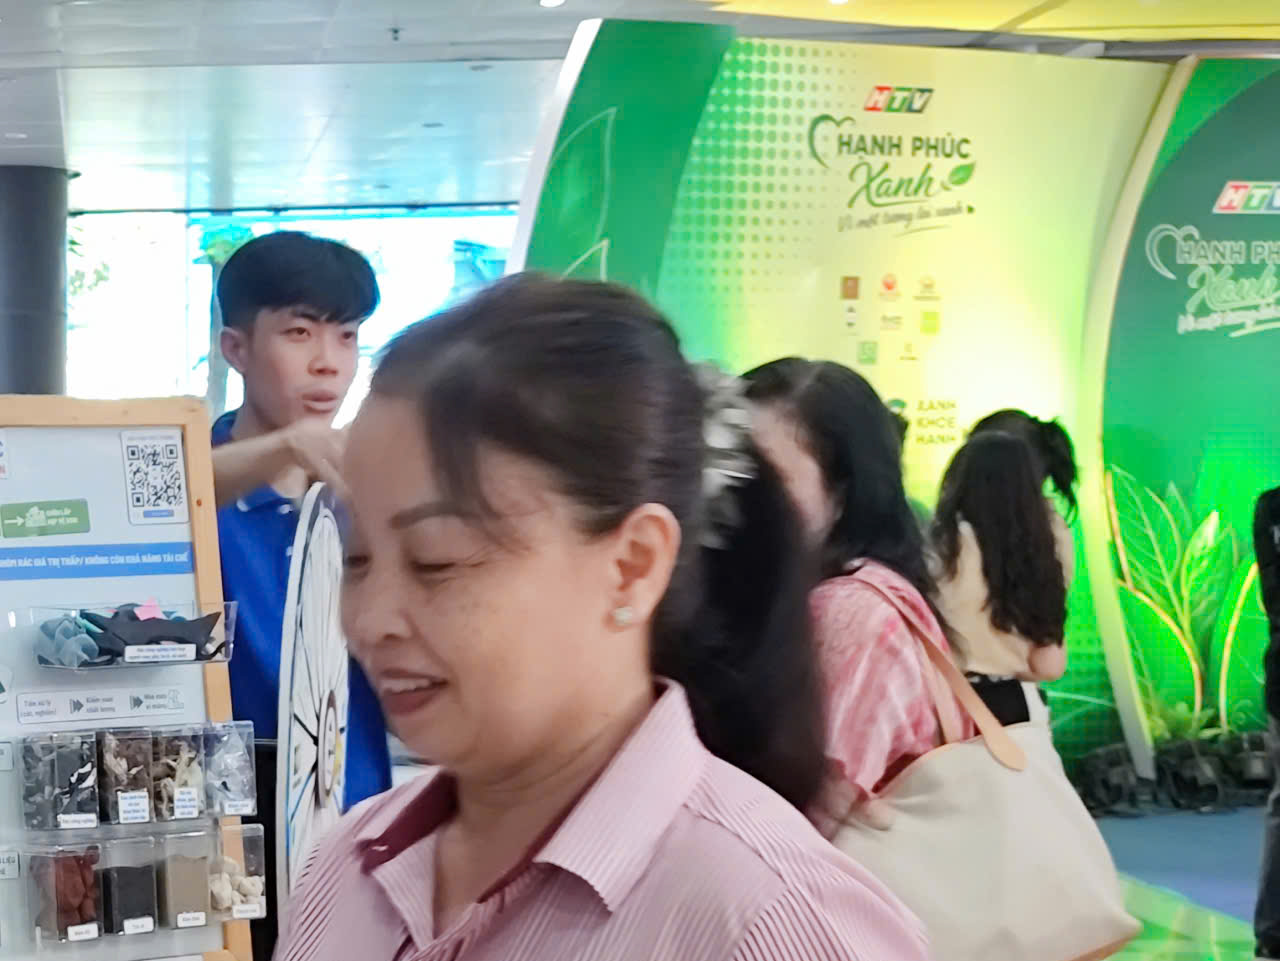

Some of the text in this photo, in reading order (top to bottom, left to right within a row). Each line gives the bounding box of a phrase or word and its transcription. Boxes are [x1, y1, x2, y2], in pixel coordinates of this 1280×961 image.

[864, 85, 934, 113] HTV
[911, 131, 971, 159] PHÚC
[848, 161, 936, 208] Xanh
